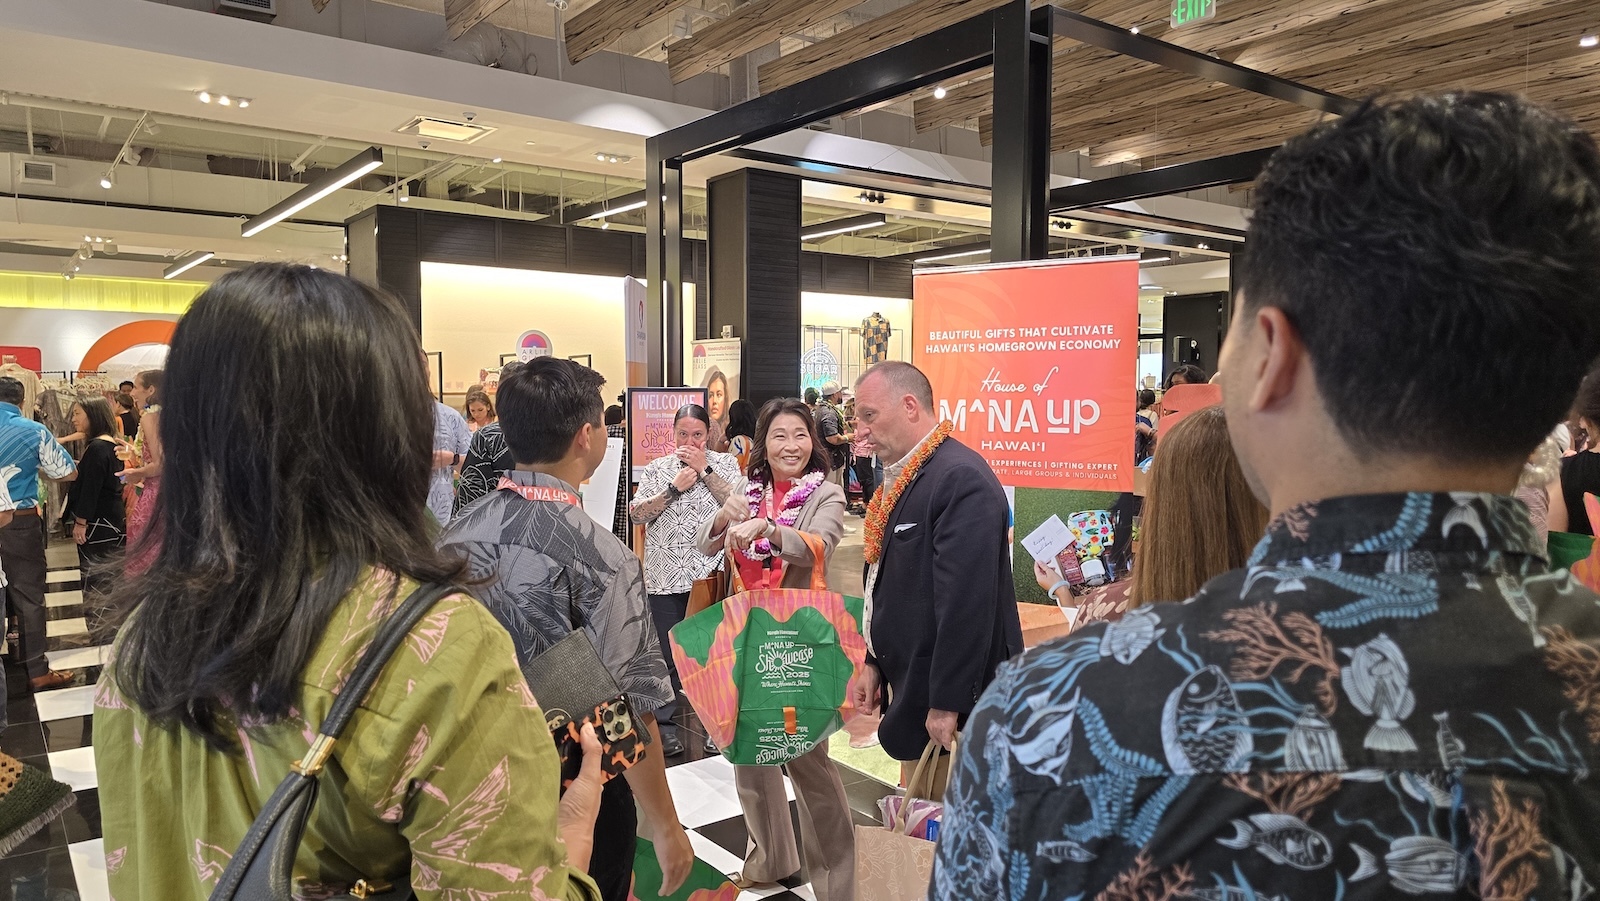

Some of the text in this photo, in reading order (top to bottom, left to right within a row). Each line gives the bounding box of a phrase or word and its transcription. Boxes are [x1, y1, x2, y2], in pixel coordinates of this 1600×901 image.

[1177, 0, 1206, 24] EXIT
[929, 324, 1114, 341] BEAUTIFUL GIFTS THAT CULTIVATE
[978, 341, 1057, 353] HOMEGROWN
[1059, 338, 1122, 351] ECONOMY
[981, 366, 1058, 396] House of
[991, 459, 1042, 468] EXPERIENCES
[1050, 461, 1084, 470] GIFTING
[1087, 463, 1118, 471] EXPERT
[1011, 469, 1033, 477] LARGE
[1035, 470, 1063, 478] GROUPS
[1072, 471, 1117, 480] INDIVIDUALS
[755, 647, 813, 673] Showcase
